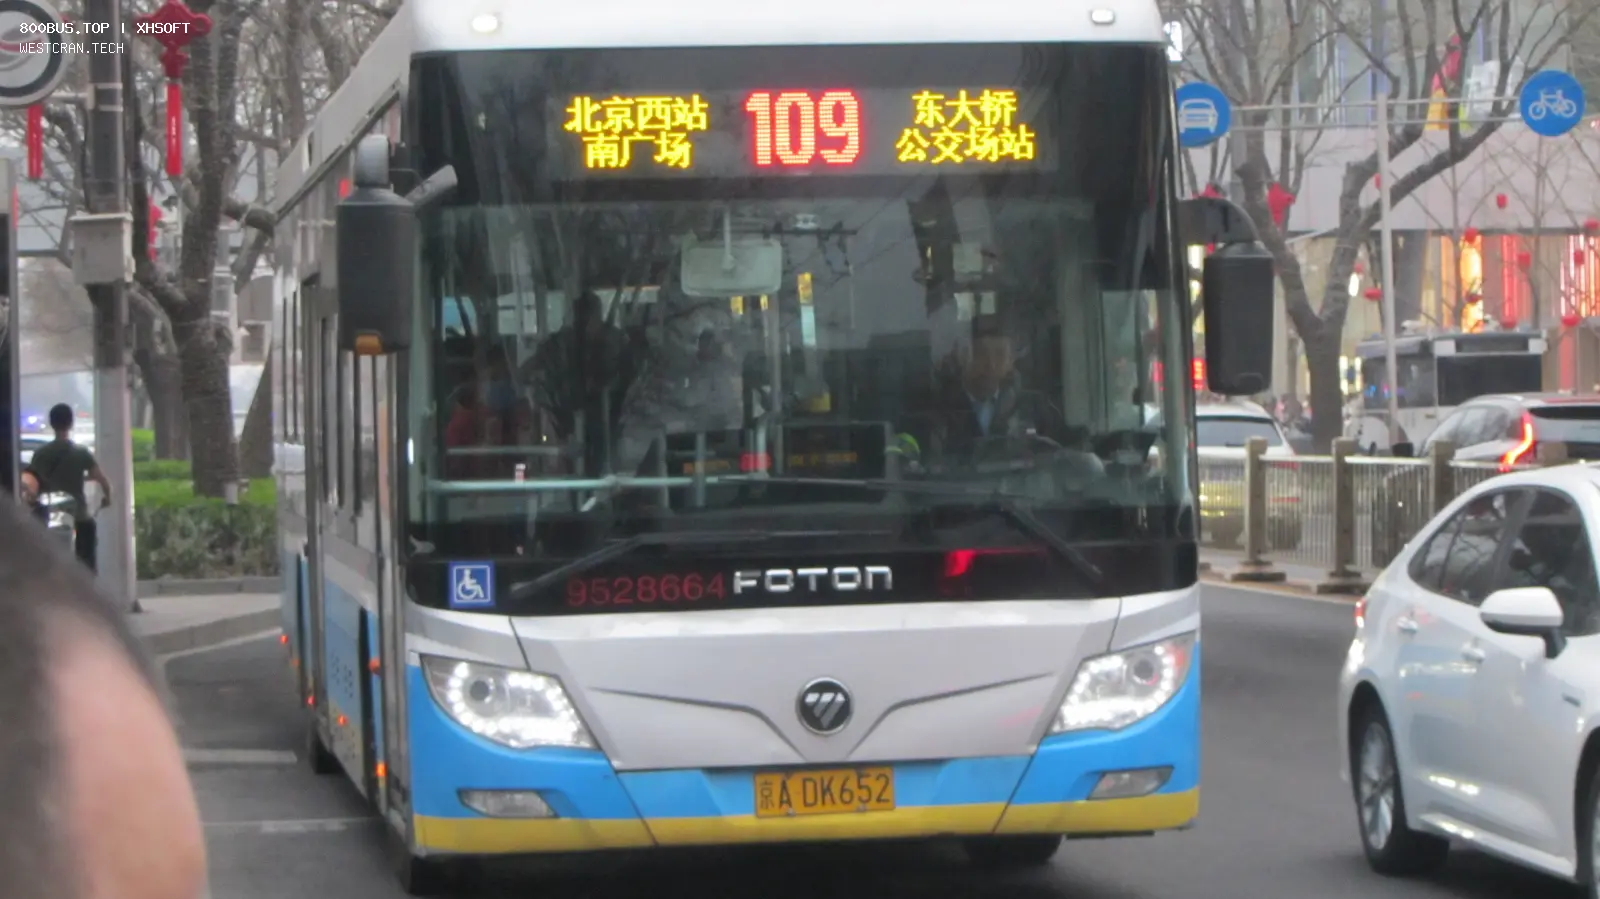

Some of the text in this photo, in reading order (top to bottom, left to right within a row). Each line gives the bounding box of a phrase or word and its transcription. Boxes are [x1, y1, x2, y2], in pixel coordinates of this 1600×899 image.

[564, 94, 708, 131] 北京西站
[911, 89, 1018, 128] 东大桥
[745, 91, 860, 165] 109
[896, 125, 1035, 164] 公交场站
[582, 132, 692, 168] 南广场
[565, 572, 726, 607] 9528664
[733, 565, 893, 595] FOTON
